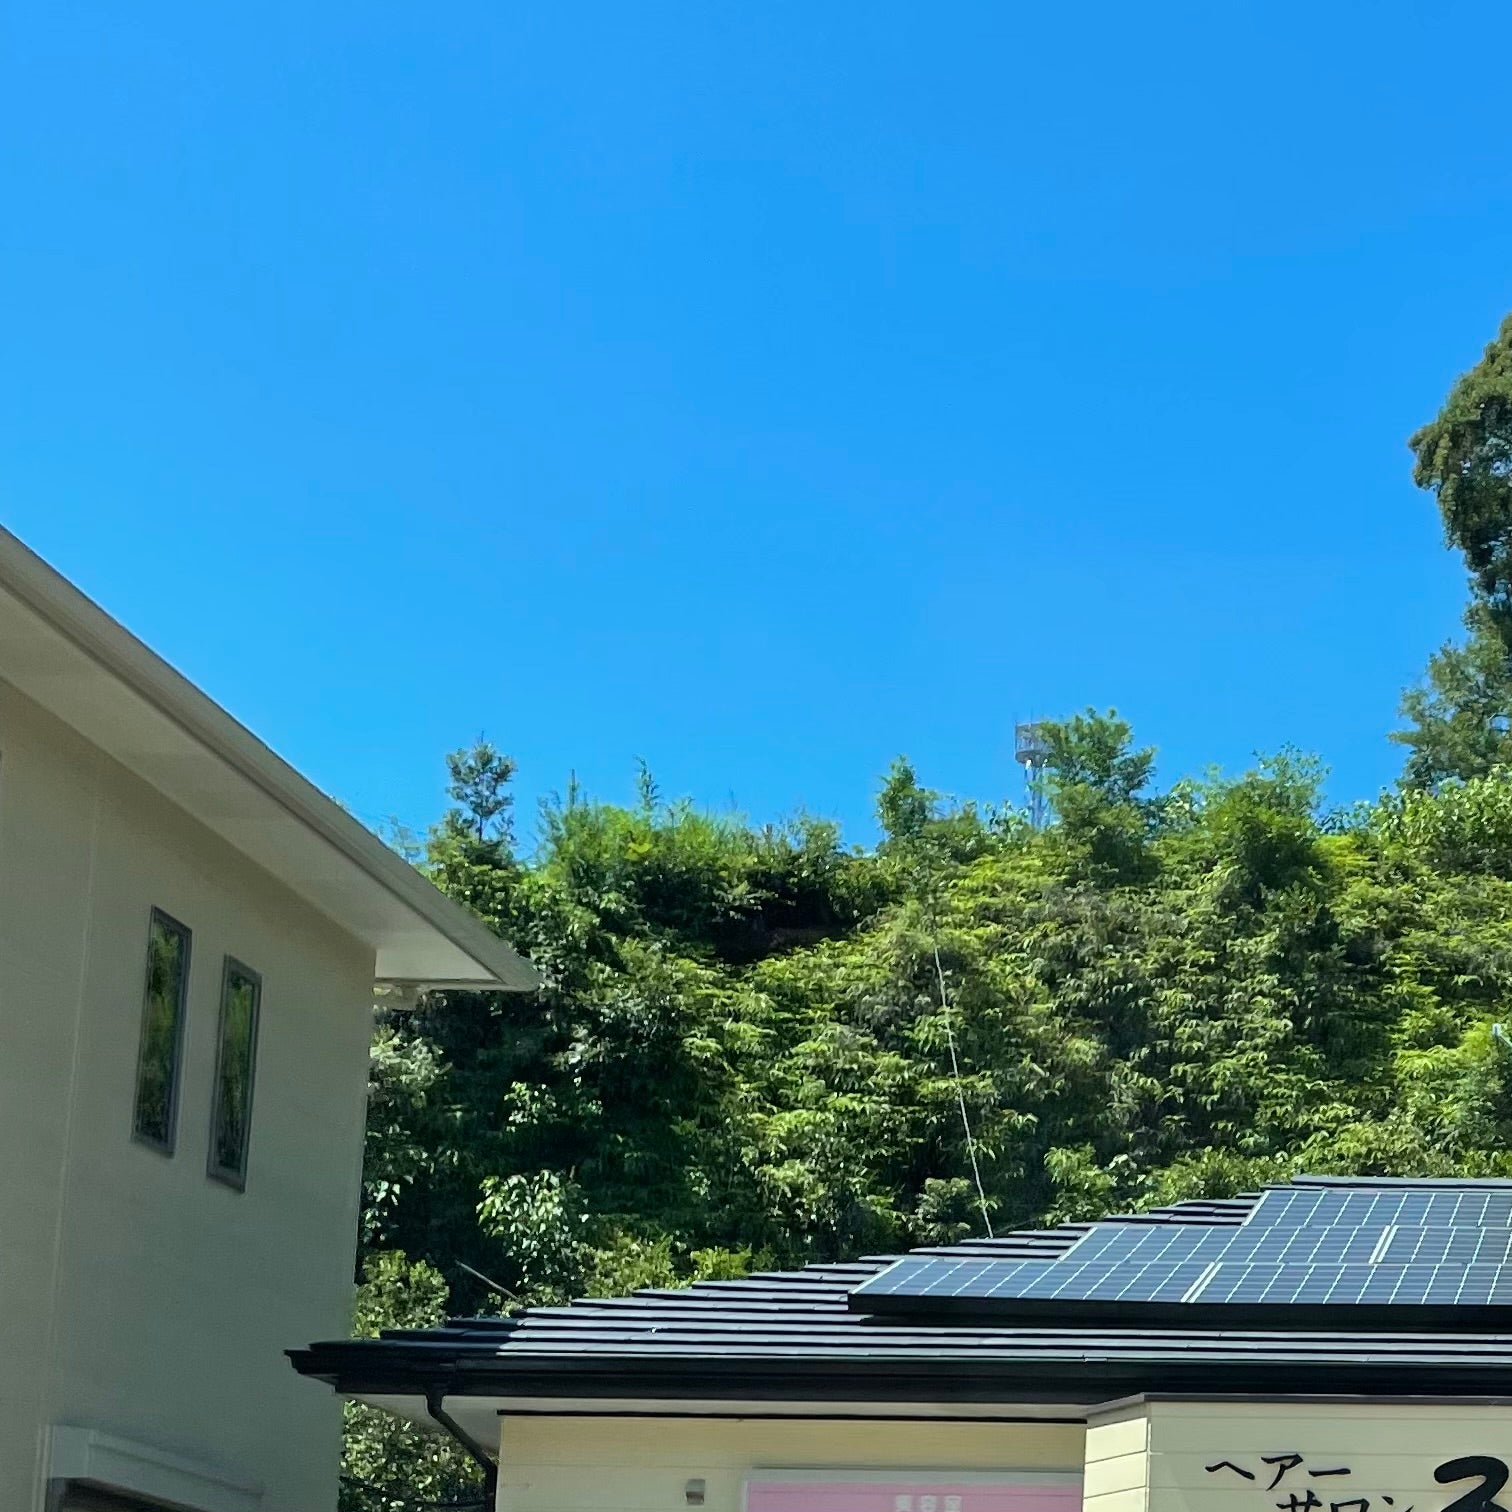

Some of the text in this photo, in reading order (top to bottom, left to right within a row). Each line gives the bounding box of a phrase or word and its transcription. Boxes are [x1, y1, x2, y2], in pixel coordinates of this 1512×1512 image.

[1204, 1453, 1351, 1491] ヘアー
[895, 1494, 962, 1512] 美容室
